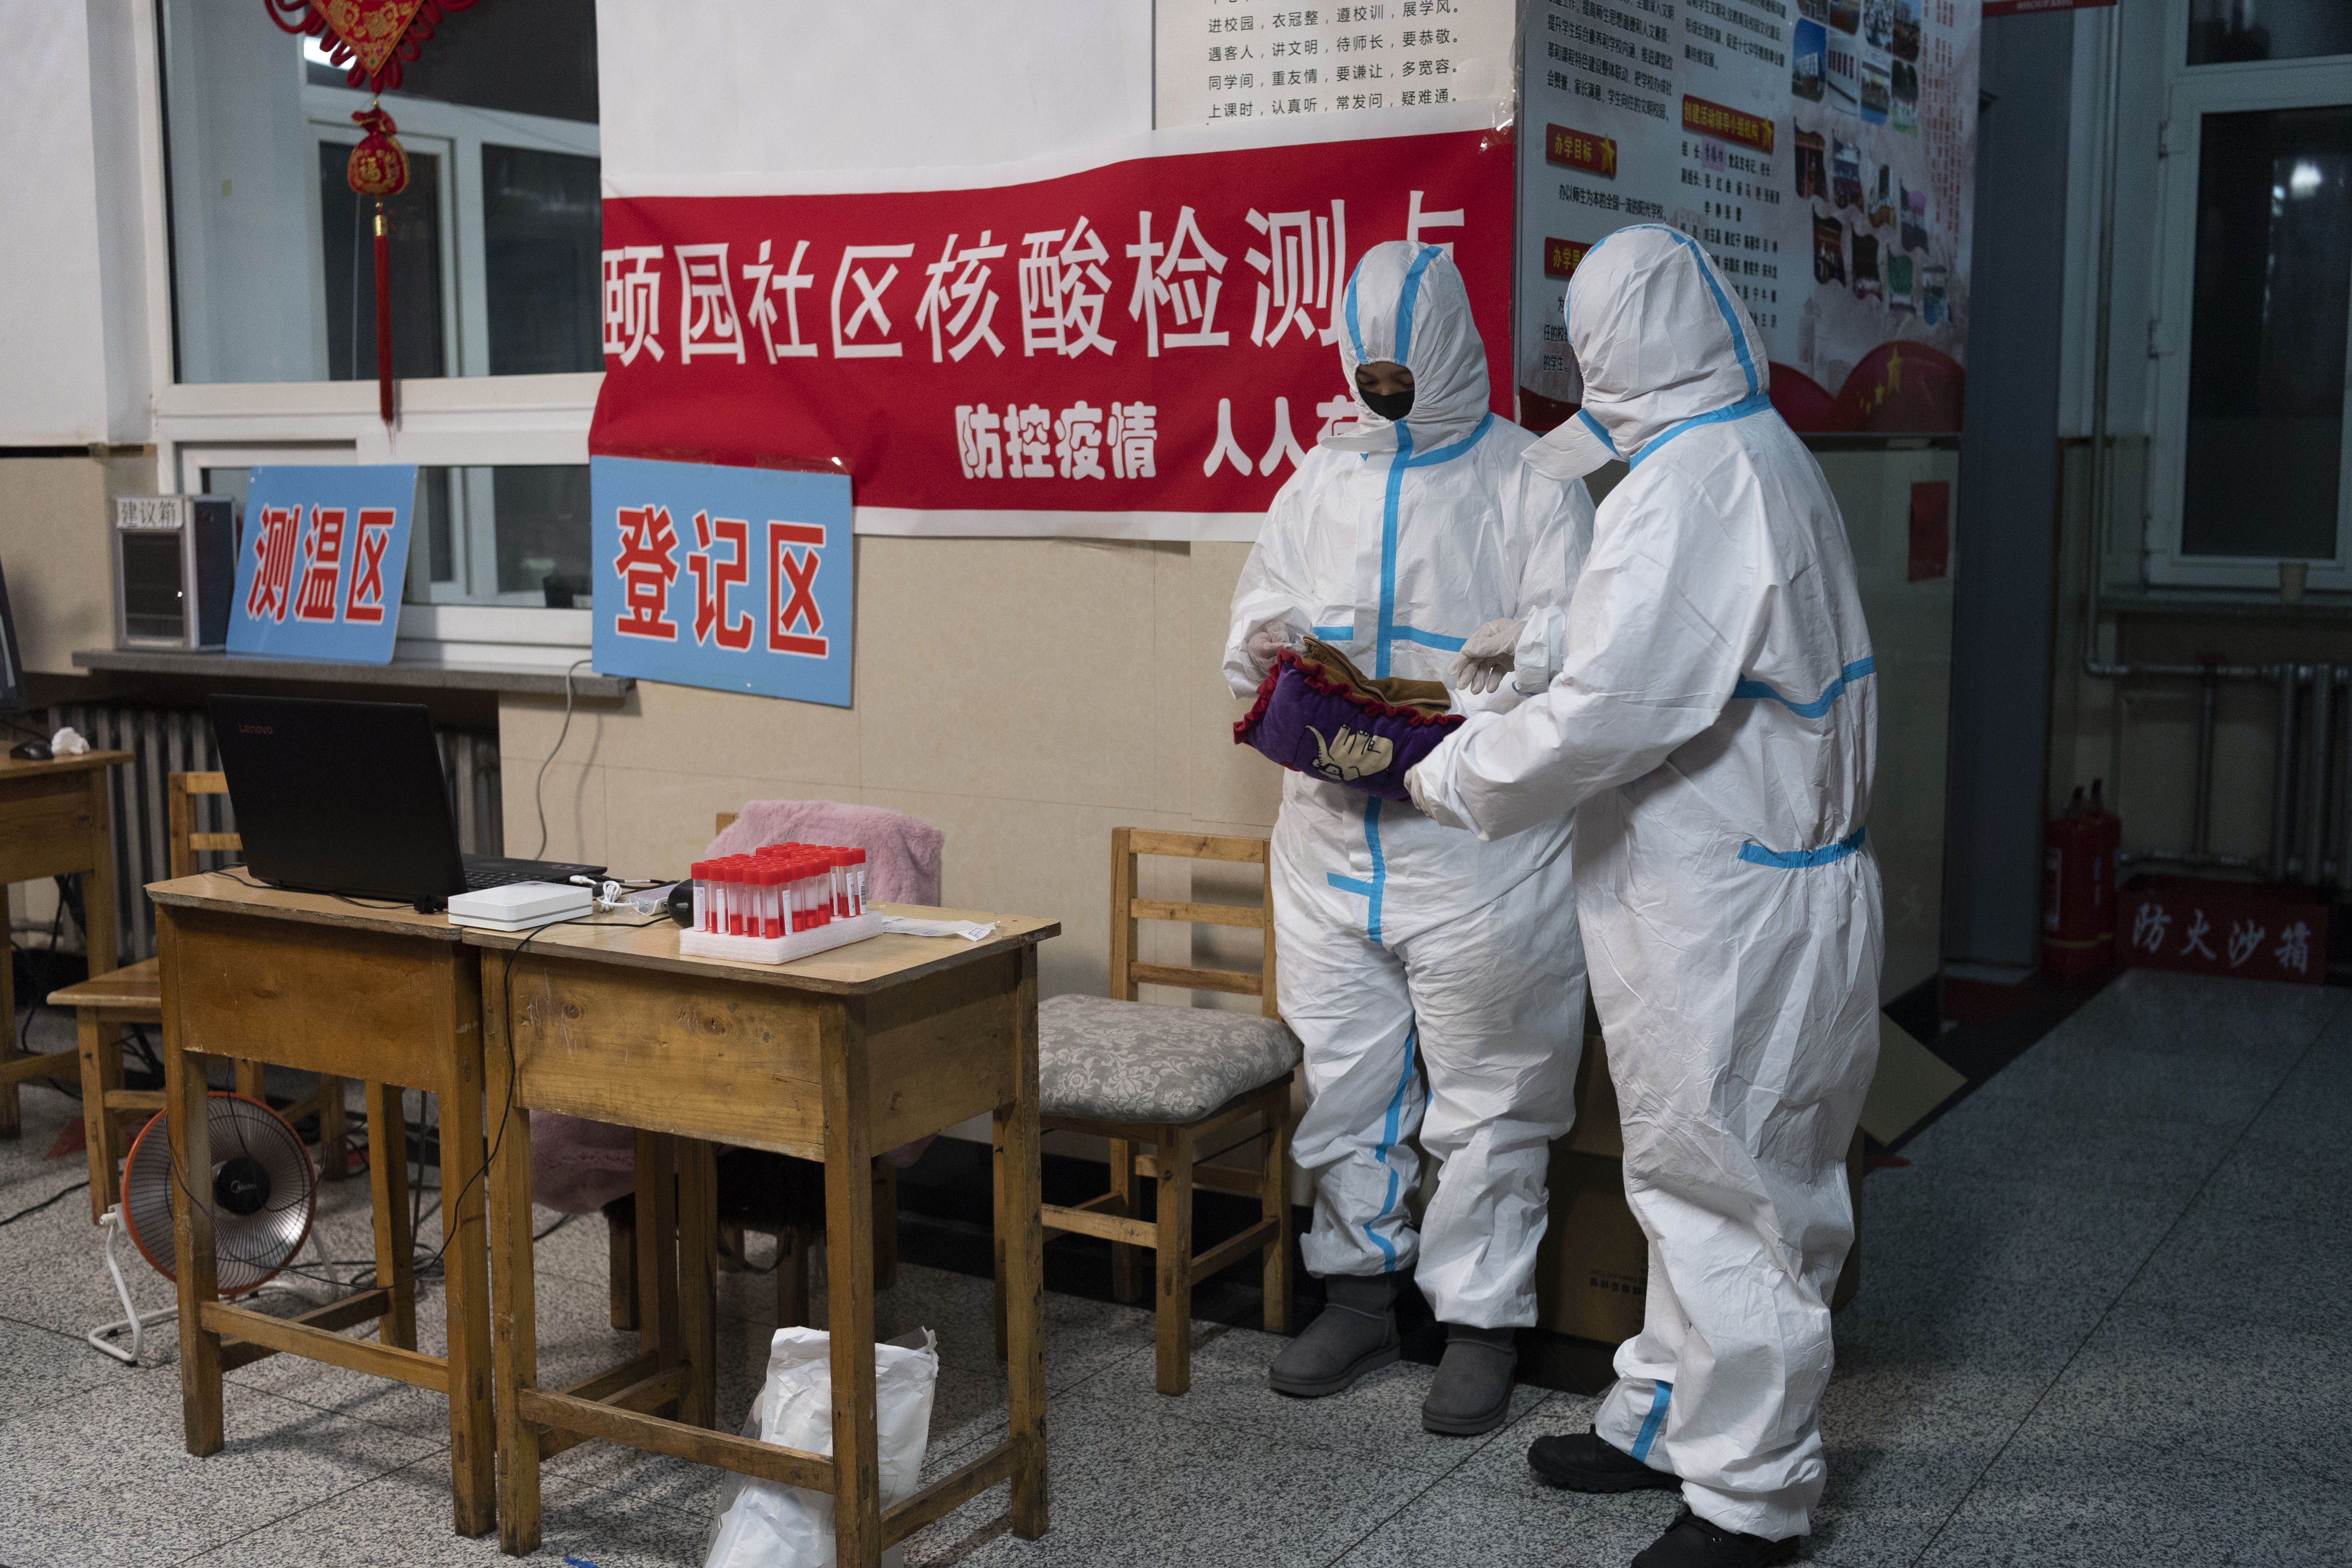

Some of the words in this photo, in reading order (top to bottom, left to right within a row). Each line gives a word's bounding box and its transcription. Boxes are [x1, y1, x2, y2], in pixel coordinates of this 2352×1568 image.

[1208, 0, 1459, 33] 进校园，衣冠整，遵校训，展学风。
[1208, 27, 1459, 63] 遇客人，讲文明，待师长，要恭敬。
[1208, 58, 1458, 90] 同学间，重友情，要谦让，多宽容。
[1208, 88, 1458, 119] 上课时，认真听，常发问，疑难通。
[1555, 133, 1592, 163] 办学目标
[1553, 246, 1586, 270] 办学思
[1543, 353, 1568, 373] 的学生。
[954, 400, 1157, 480] 防控疫情
[121, 499, 176, 527] 建议箱
[245, 502, 396, 625] 测温区
[612, 504, 829, 659] 登记区
[237, 721, 273, 735] Lenovo
[2132, 903, 2311, 975] 防火沙箱
